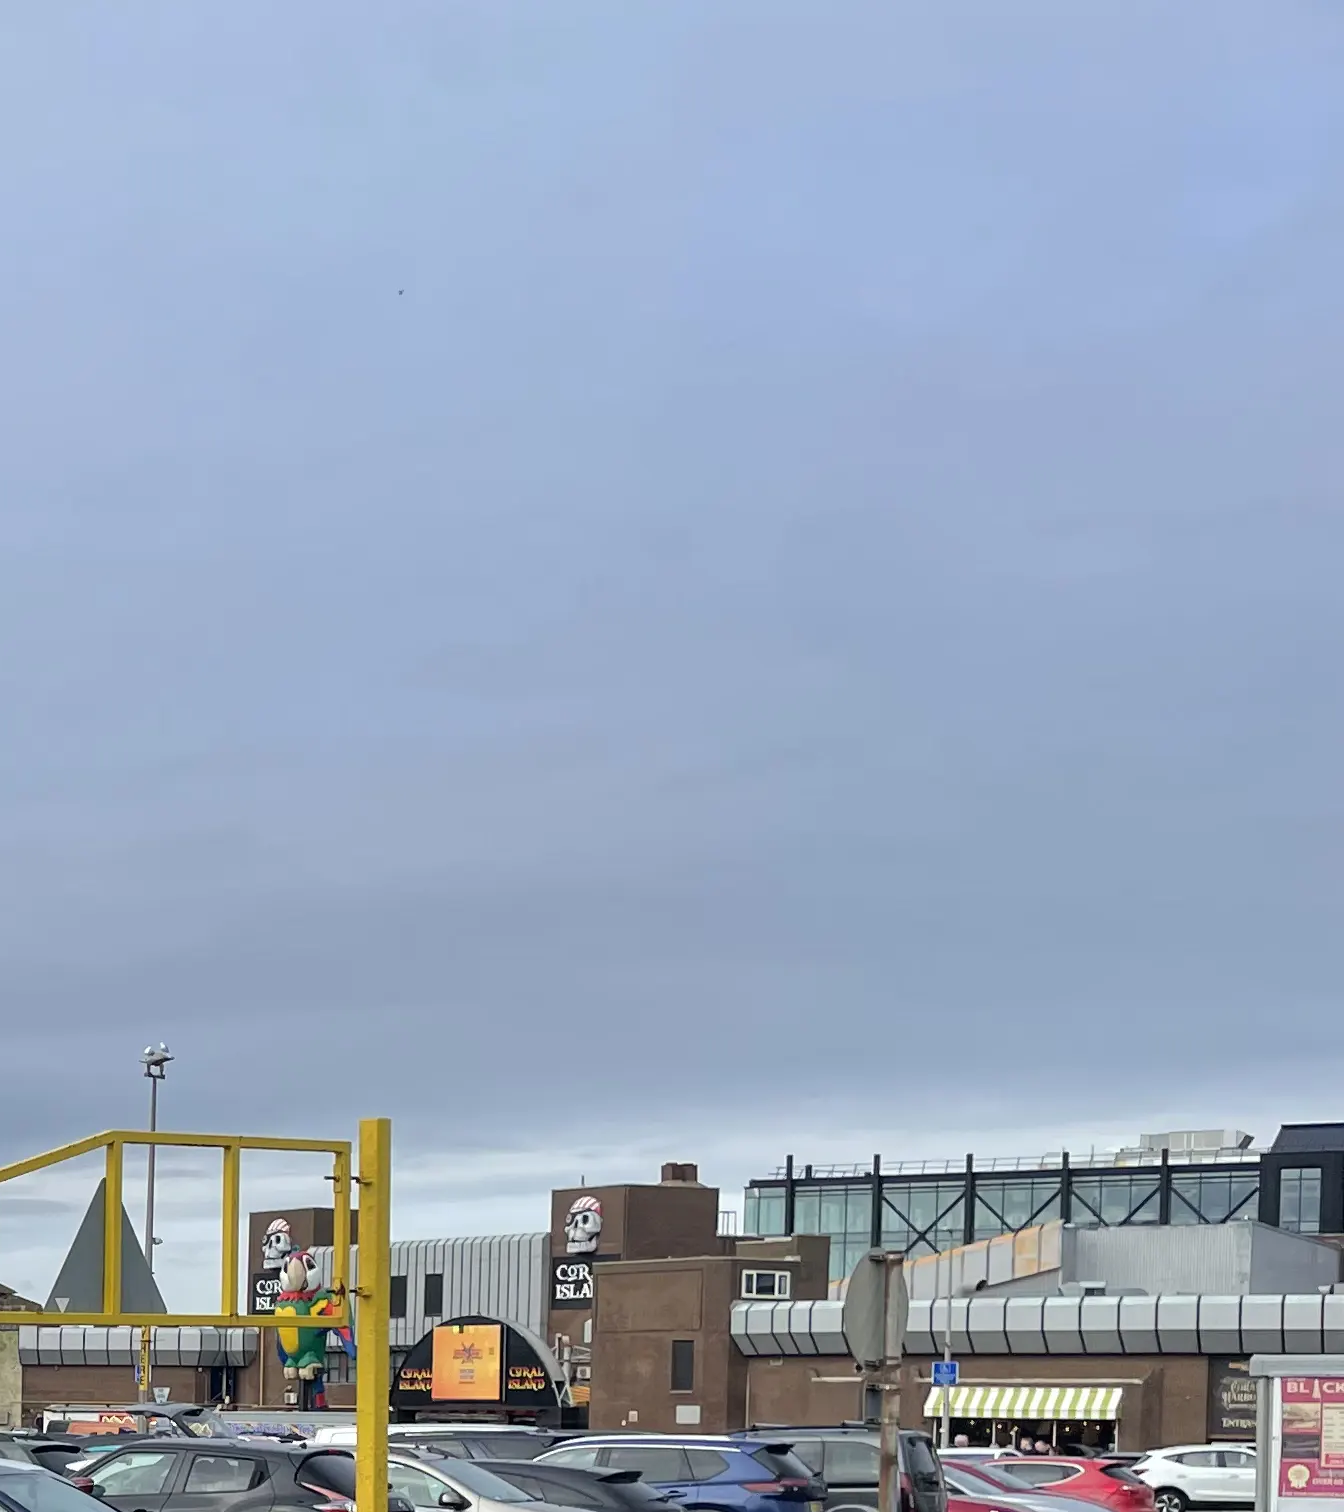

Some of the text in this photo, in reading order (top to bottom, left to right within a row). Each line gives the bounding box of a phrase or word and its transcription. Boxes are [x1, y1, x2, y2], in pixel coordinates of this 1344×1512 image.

[555, 1263, 593, 1283] COR
[255, 1279, 282, 1295] COR
[555, 1283, 593, 1300] ISLA
[255, 1296, 275, 1311] ISL
[509, 1366, 545, 1379] CORAL
[508, 1379, 546, 1391] ISLAND
